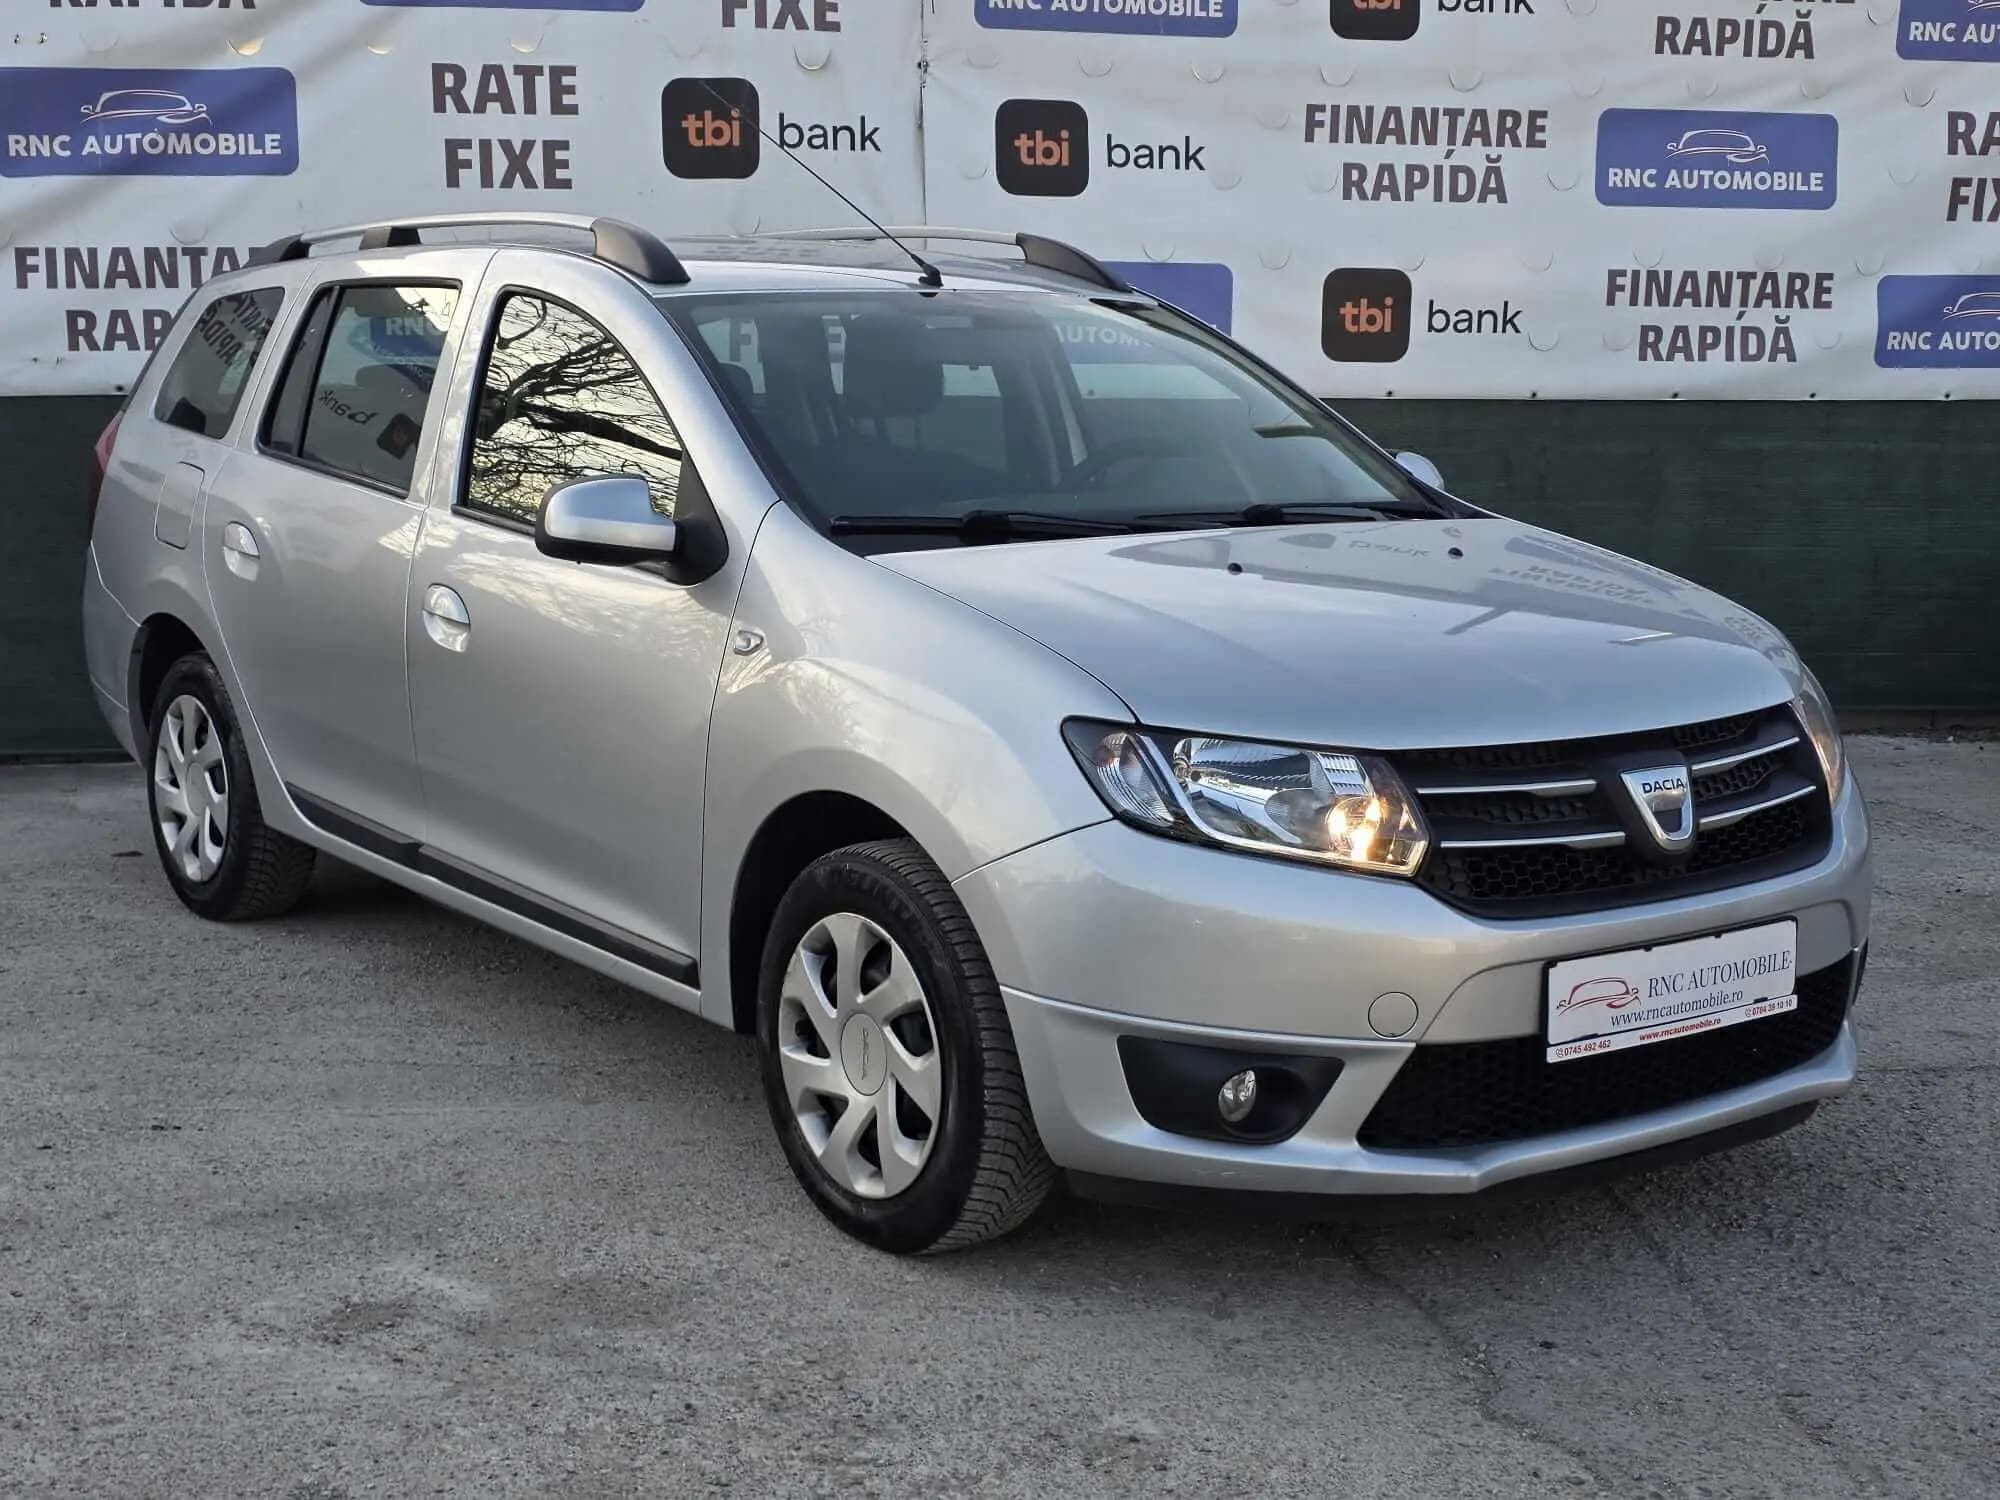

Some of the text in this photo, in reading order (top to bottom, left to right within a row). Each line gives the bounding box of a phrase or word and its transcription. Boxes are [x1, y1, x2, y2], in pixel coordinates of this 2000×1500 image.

[722, 0, 841, 32] FIXE
[1908, 21, 1957, 42] RNC
[432, 63, 579, 116] RATE
[8, 132, 281, 157] RNC AUTOMOBILE
[682, 108, 881, 152] tbi bank
[445, 138, 573, 189] FIXE
[1014, 130, 1206, 170] tbi bank
[1608, 168, 1824, 192] RNC AUTOMOBILE
[1339, 297, 1522, 334] tbi bank
[1887, 331, 2000, 350] RNC AUTO
[1641, 778, 1685, 794] DACIA
[1648, 950, 1791, 998] RNC AUTOMOBILE
[1610, 989, 1743, 1028] www.rncautomobile.ro
[1639, 1017, 1721, 1042] www.rncautomobile.ro
[1564, 1045, 1582, 1057] 0745
